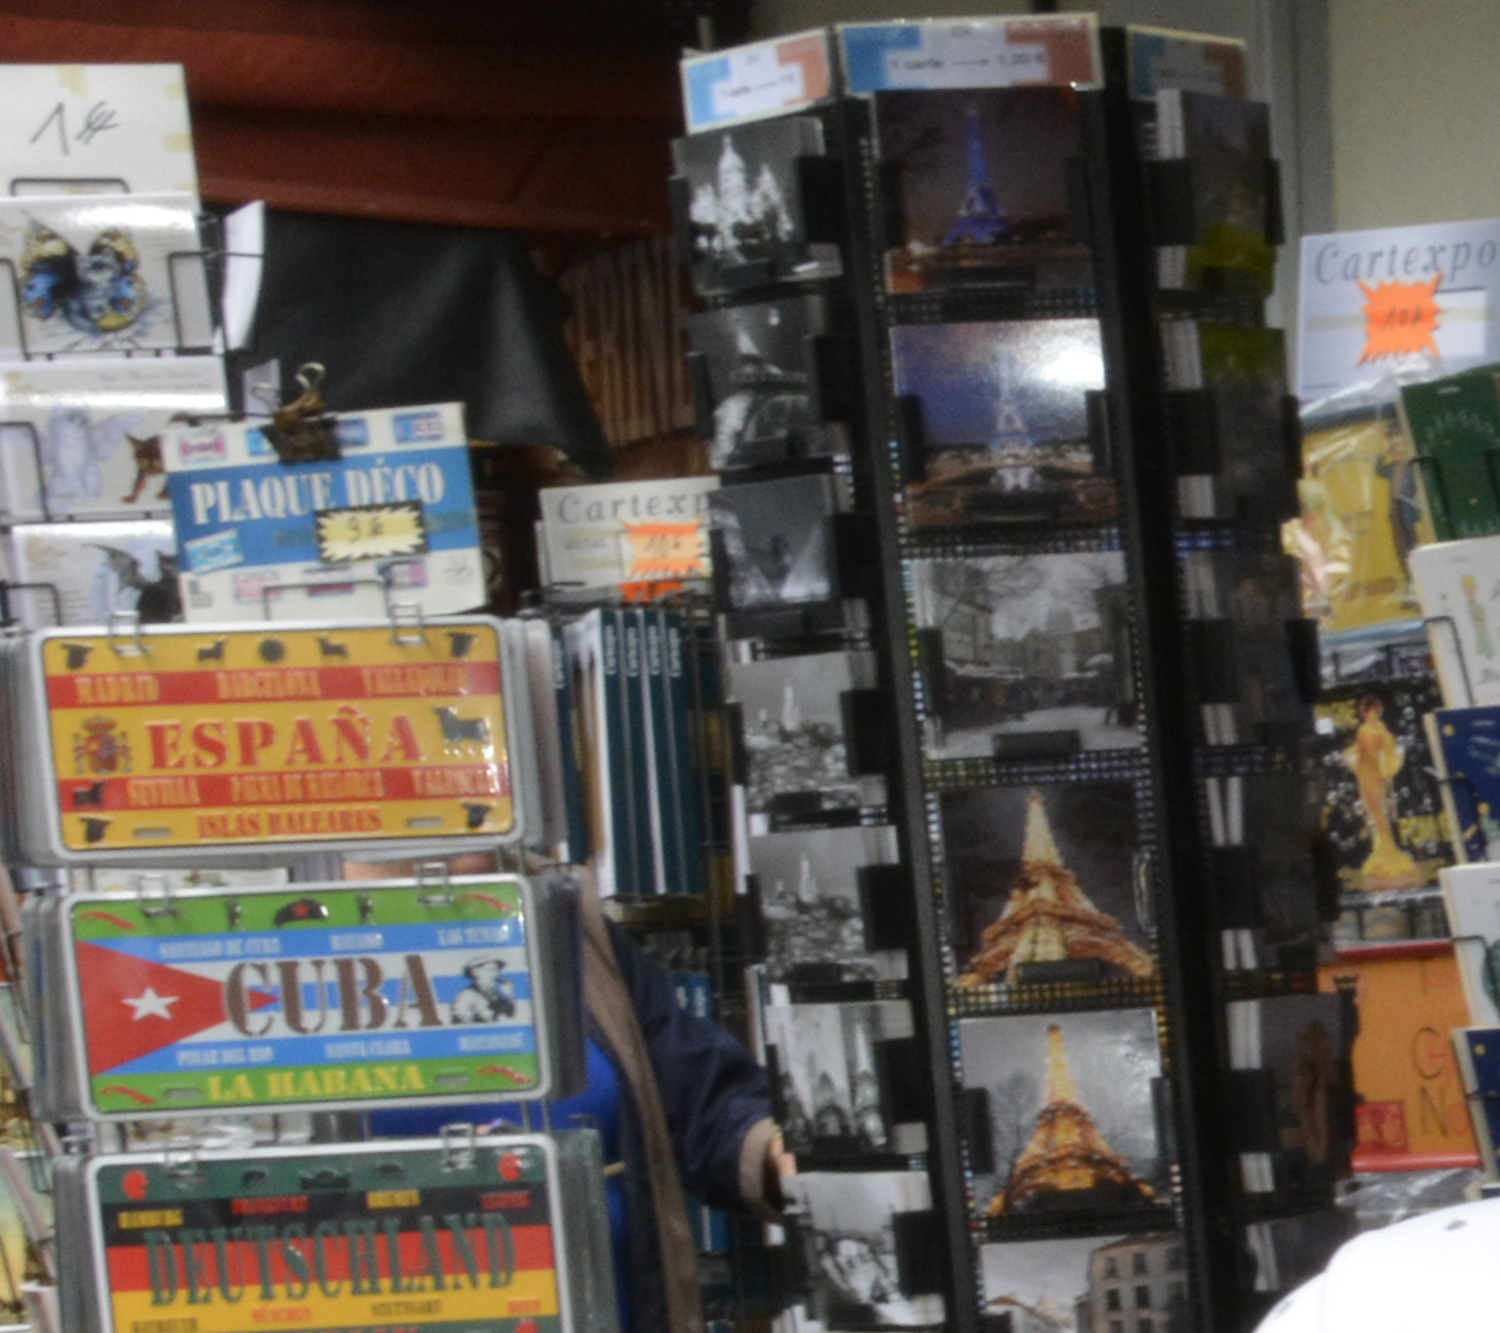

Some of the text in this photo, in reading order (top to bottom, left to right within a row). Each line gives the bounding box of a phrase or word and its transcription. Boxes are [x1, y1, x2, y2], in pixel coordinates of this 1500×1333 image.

[1315, 239, 1497, 284] Cartexpo
[189, 456, 446, 525] PLAQUE DÉCO
[557, 491, 709, 525] Cartexp
[73, 673, 161, 704] MADRID
[215, 669, 322, 700] BARCELONA
[144, 703, 427, 771] ESPAÑA
[126, 777, 202, 807] SEVILLA
[197, 807, 383, 838] ISLAS BALEARES
[225, 953, 443, 1037] CUBA
[208, 1064, 426, 1102] LA HABANA
[143, 1212, 516, 1307] DEUTSCHLAND
